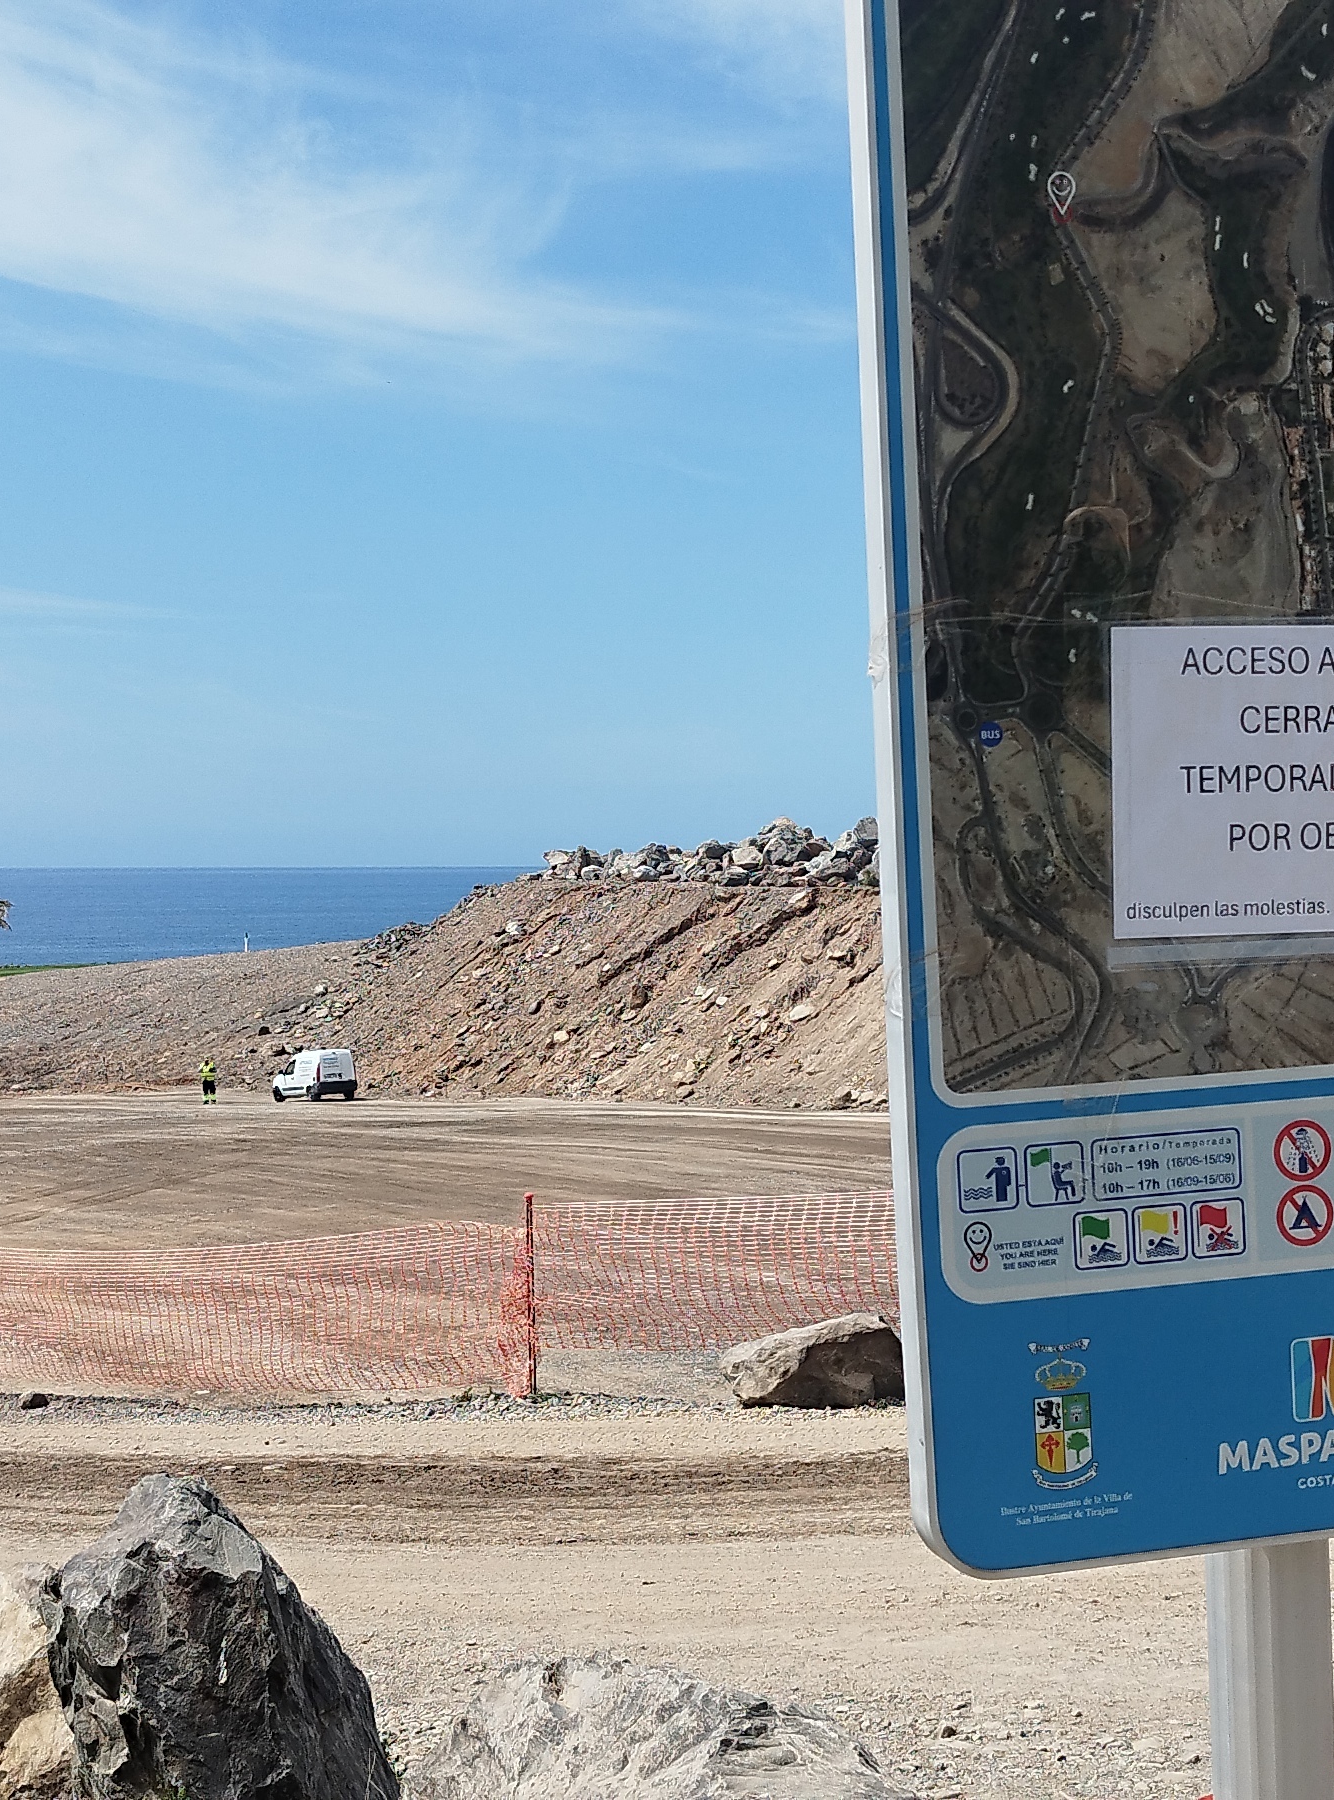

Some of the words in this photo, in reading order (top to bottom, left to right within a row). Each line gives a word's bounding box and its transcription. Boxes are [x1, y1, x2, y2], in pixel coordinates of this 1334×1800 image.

[1181, 646, 1310, 675] ACCESO
[980, 730, 1001, 740] BUS
[1229, 823, 1291, 851] POR
[1126, 901, 1210, 921] disculpen
[1214, 901, 1239, 917] las
[1244, 898, 1331, 917] molestias.
[1100, 1161, 1123, 1174] 10h
[1137, 1158, 1159, 1171] 19h
[1102, 1182, 1124, 1194] 10h
[1138, 1178, 1160, 1191] 17h
[1000, 1252, 1017, 1260] YOU
[1019, 1250, 1035, 1259] ARE
[1037, 1248, 1059, 1257] HERE
[1123, 1491, 1133, 1501] de
